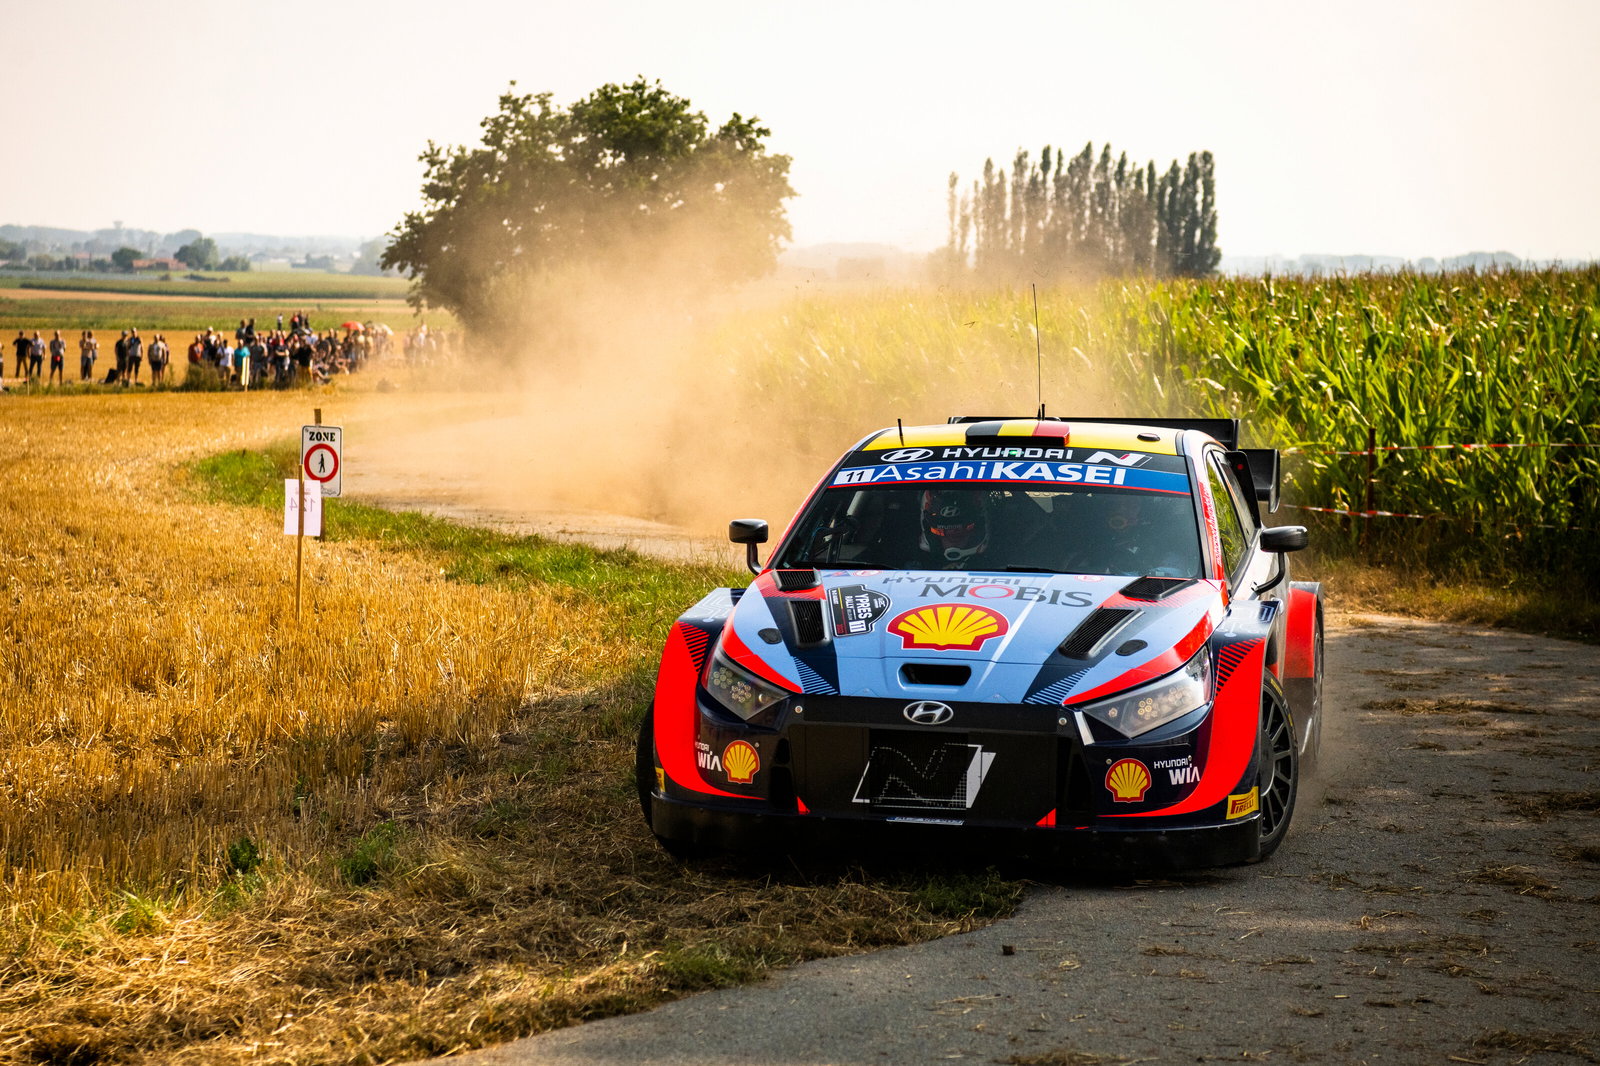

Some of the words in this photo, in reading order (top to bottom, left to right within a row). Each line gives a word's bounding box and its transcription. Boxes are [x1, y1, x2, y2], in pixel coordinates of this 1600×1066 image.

[309, 431, 336, 442] ZONE
[942, 447, 1073, 459] HYUNDAI
[846, 470, 865, 482] 11
[882, 575, 1023, 586] HYUNDAI
[918, 583, 1093, 608] MOBIS
[855, 593, 872, 619] YPRES
[1153, 757, 1189, 769] HYUNDAI
[1230, 792, 1254, 815] PIRELLI
